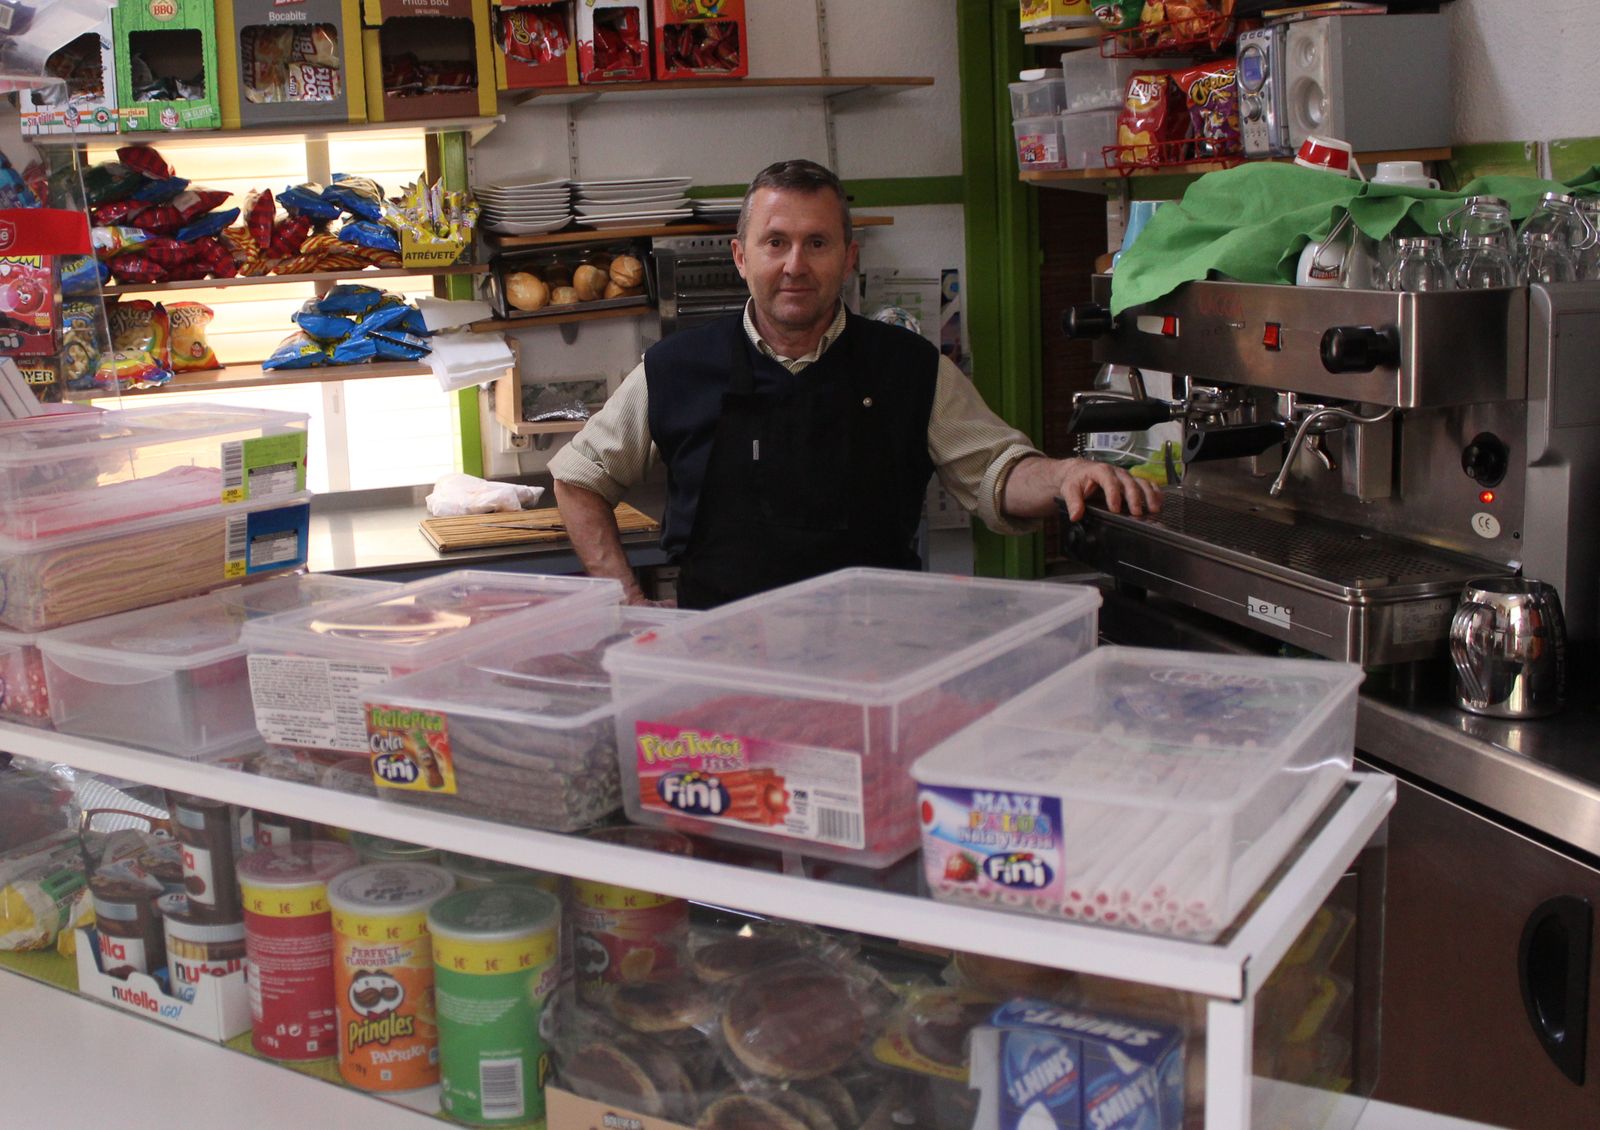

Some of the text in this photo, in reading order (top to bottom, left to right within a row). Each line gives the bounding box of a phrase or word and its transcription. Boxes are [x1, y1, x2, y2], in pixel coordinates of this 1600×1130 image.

[153, 4, 173, 16] BBQ
[268, 11, 307, 21] Bocabits
[1128, 78, 1162, 101] Lay's
[1190, 69, 1237, 106] Cheetos
[376, 757, 416, 782] Fini
[663, 776, 722, 815] Fini
[972, 791, 1042, 816] MAXI
[968, 811, 1052, 835] PALOS
[988, 854, 1047, 888] Fini
[357, 924, 369, 937] 1€
[387, 927, 400, 939] 1€
[485, 958, 499, 971] 1€
[111, 984, 159, 1014] nutella
[348, 1012, 416, 1054] Pringles
